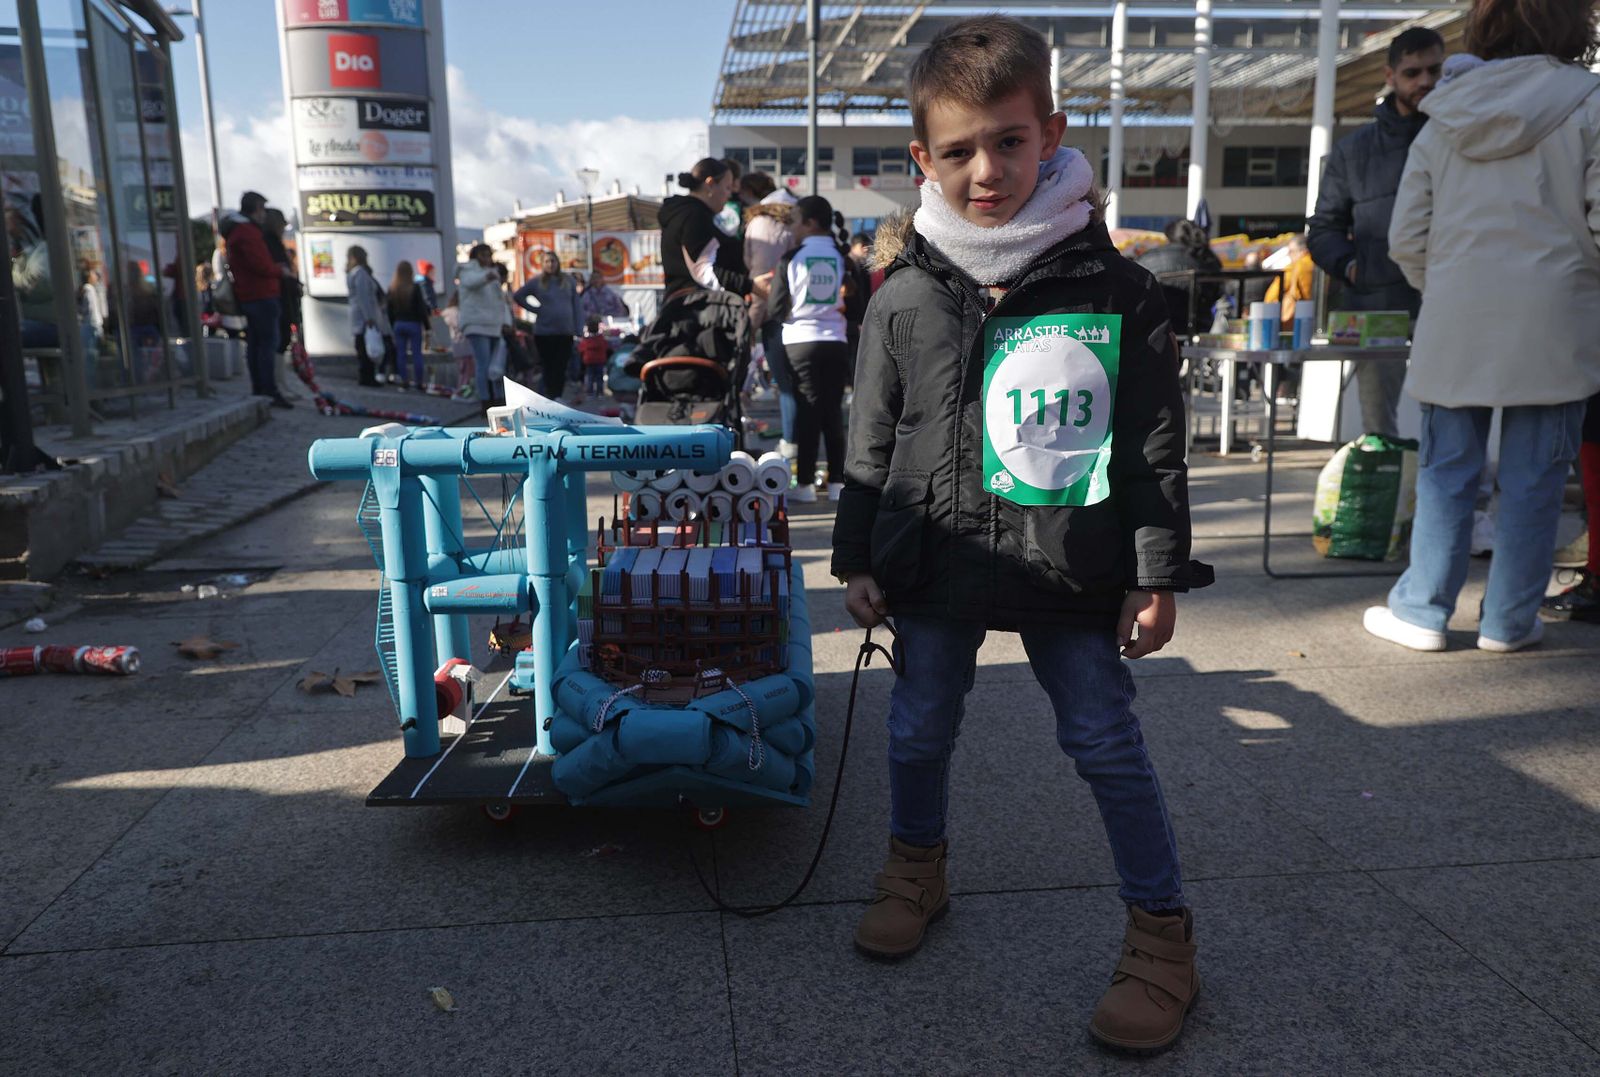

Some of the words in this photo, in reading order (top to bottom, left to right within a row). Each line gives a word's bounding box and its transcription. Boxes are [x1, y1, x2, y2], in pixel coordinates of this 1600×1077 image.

[994, 325, 1068, 341] ARRASTRE
[1004, 338, 1052, 354] LATAS
[1006, 388, 1093, 427] 1113
[512, 444, 567, 459] APM
[577, 444, 705, 459] TERMINALS
